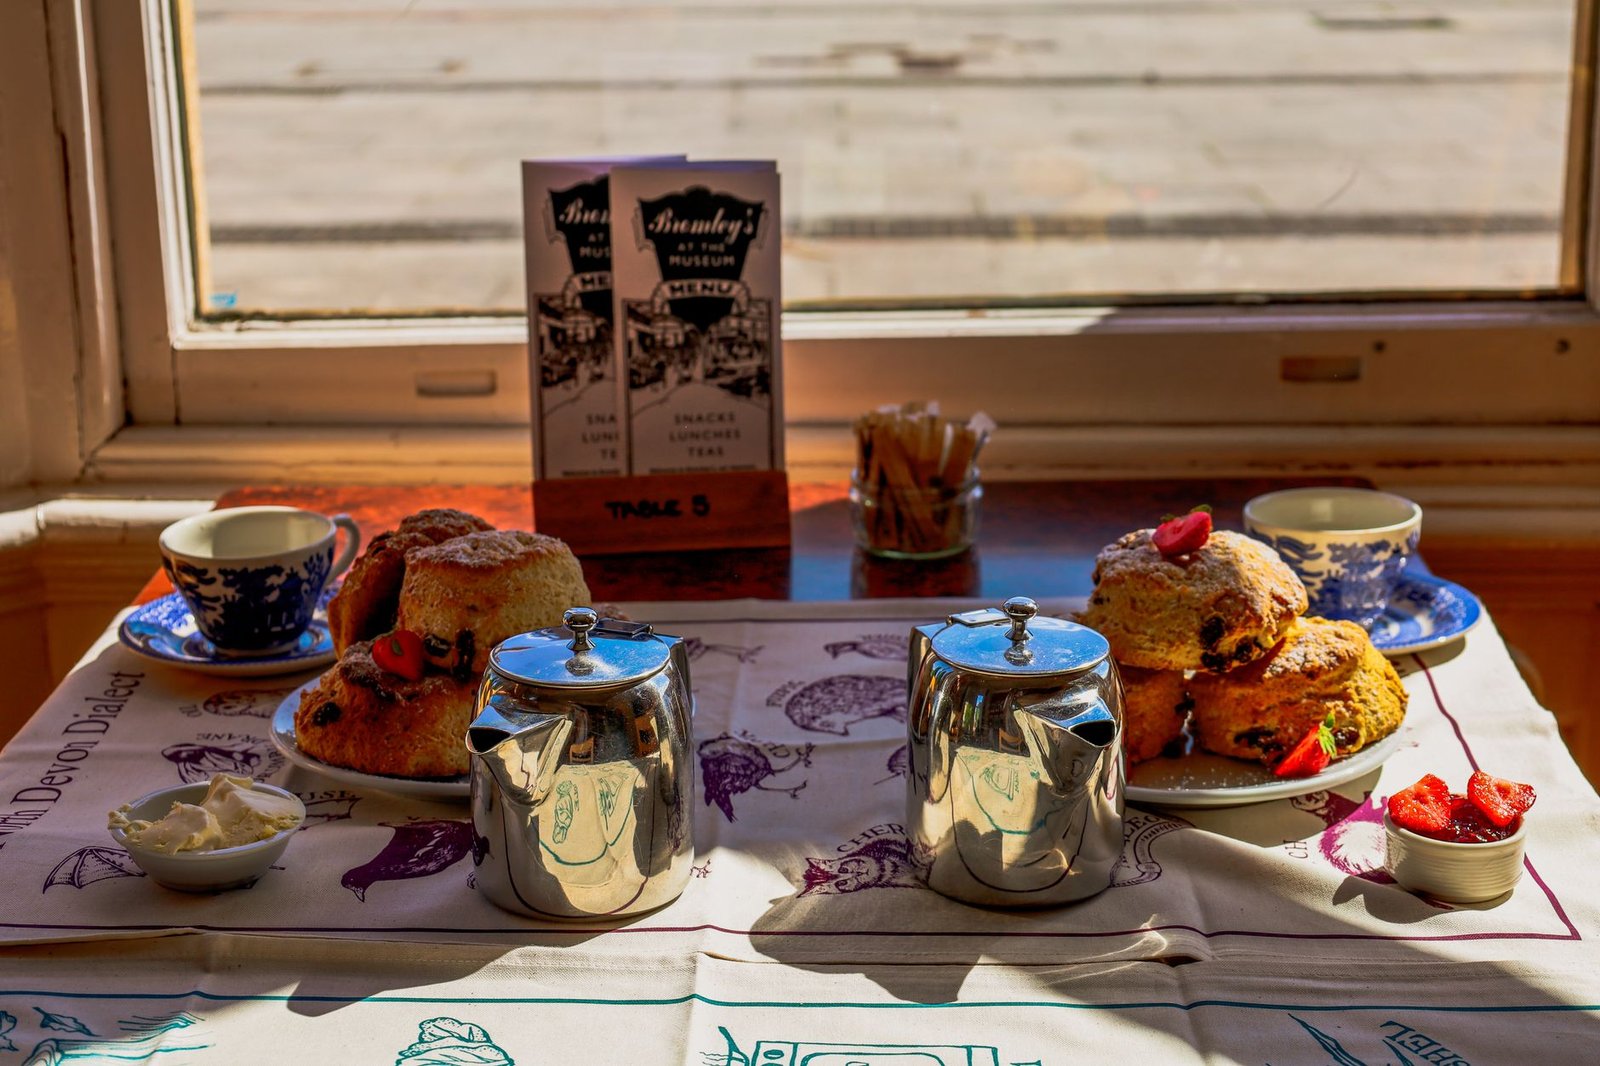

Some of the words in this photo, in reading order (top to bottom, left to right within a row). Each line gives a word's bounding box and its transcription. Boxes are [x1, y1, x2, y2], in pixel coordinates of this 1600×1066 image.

[648, 206, 754, 245] Bromley's
[579, 246, 611, 258] MUS
[677, 242, 695, 252] AT
[701, 242, 726, 252] THE
[669, 255, 736, 267] MUSEUM
[580, 275, 611, 289] ME
[669, 282, 734, 295] MENU
[586, 413, 618, 426] SNA
[674, 411, 737, 426] SNACKS
[669, 429, 742, 442] LUNCHES
[602, 448, 618, 460] TE
[688, 446, 725, 458] TEAS
[605, 499, 682, 520] TABLE
[692, 494, 711, 517] 5
[10, 739, 100, 804] Devon
[62, 669, 146, 736] Dialect
